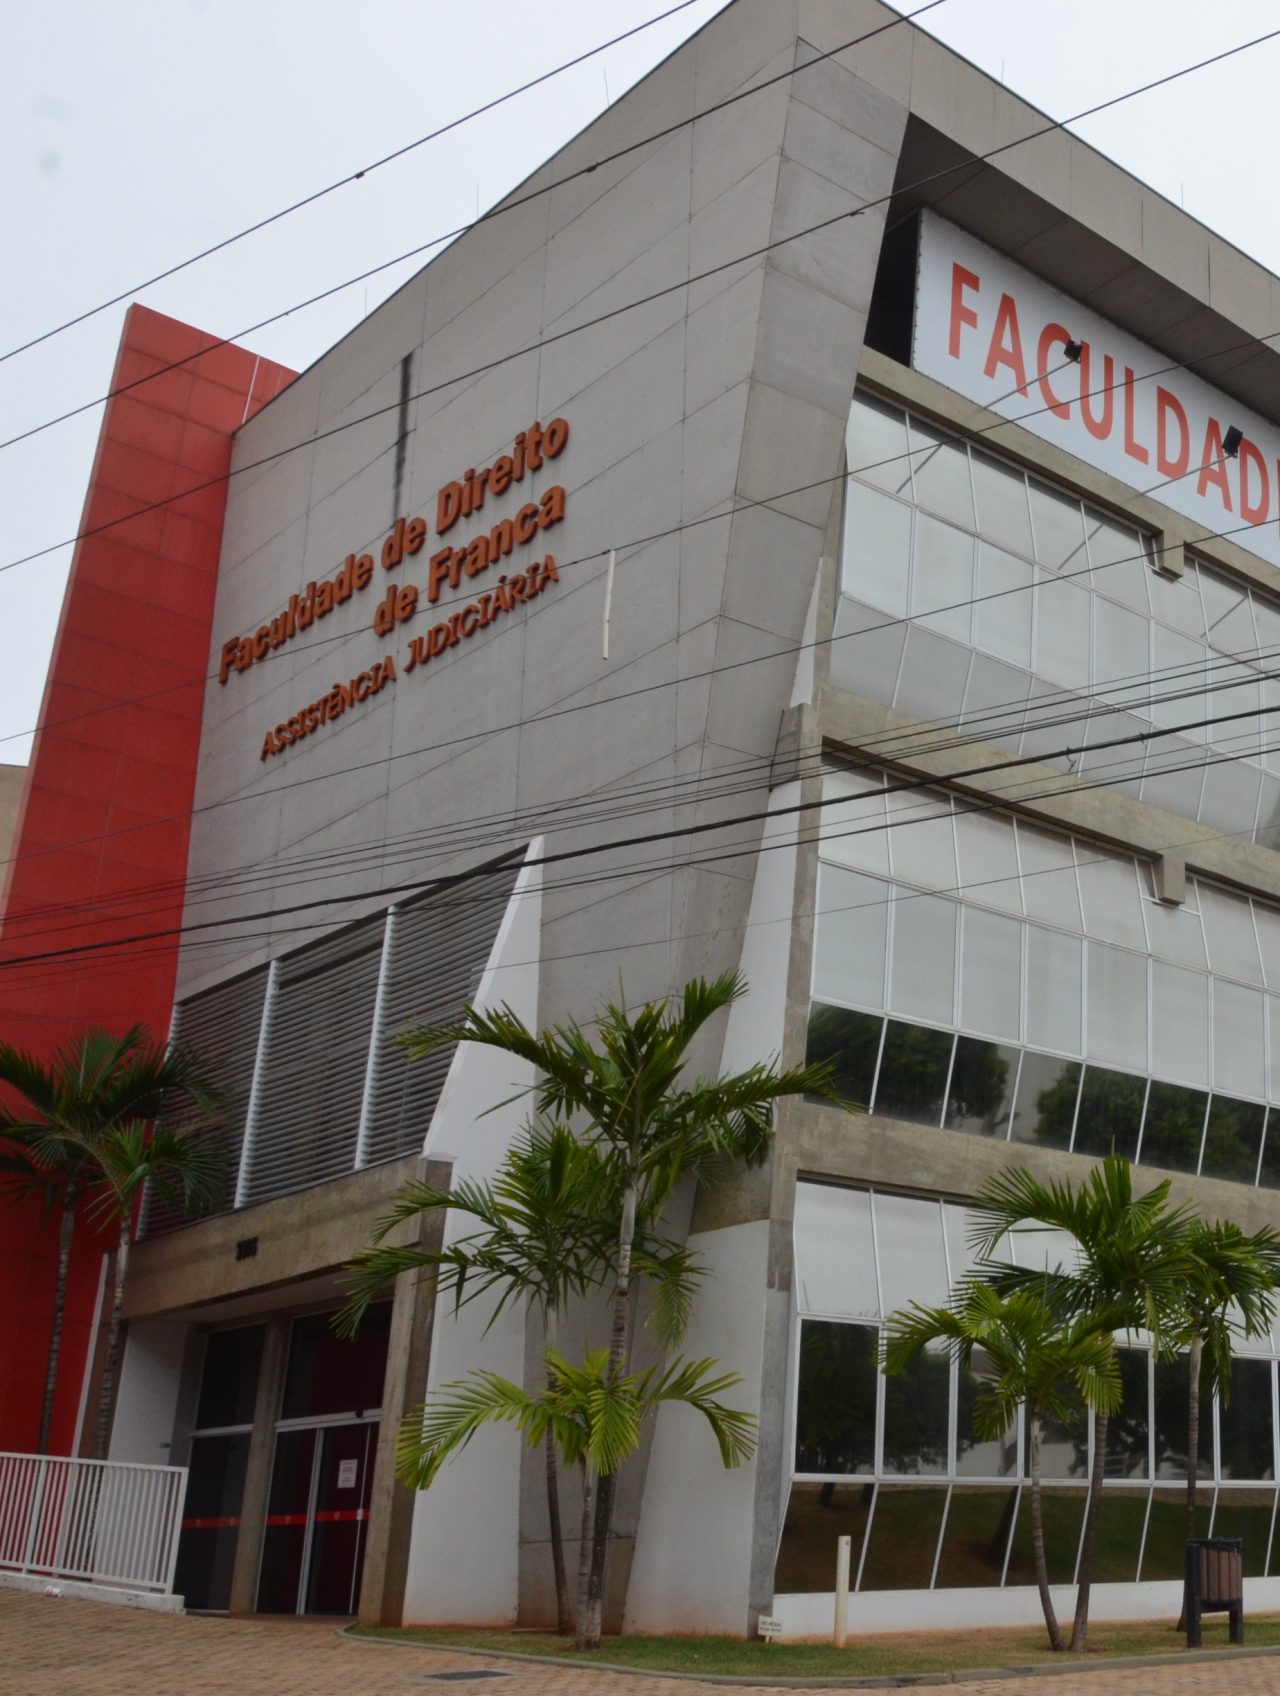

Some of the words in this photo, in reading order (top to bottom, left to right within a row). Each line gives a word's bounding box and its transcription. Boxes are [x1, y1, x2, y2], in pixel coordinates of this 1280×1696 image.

[218, 553, 374, 685] Faculdade
[380, 516, 427, 571] de
[435, 417, 570, 536] Direito
[373, 583, 419, 638] de
[426, 484, 566, 604] Franca
[259, 655, 398, 763] ASSISTÊNCIA
[403, 554, 560, 674] JUDICIÁRIA
